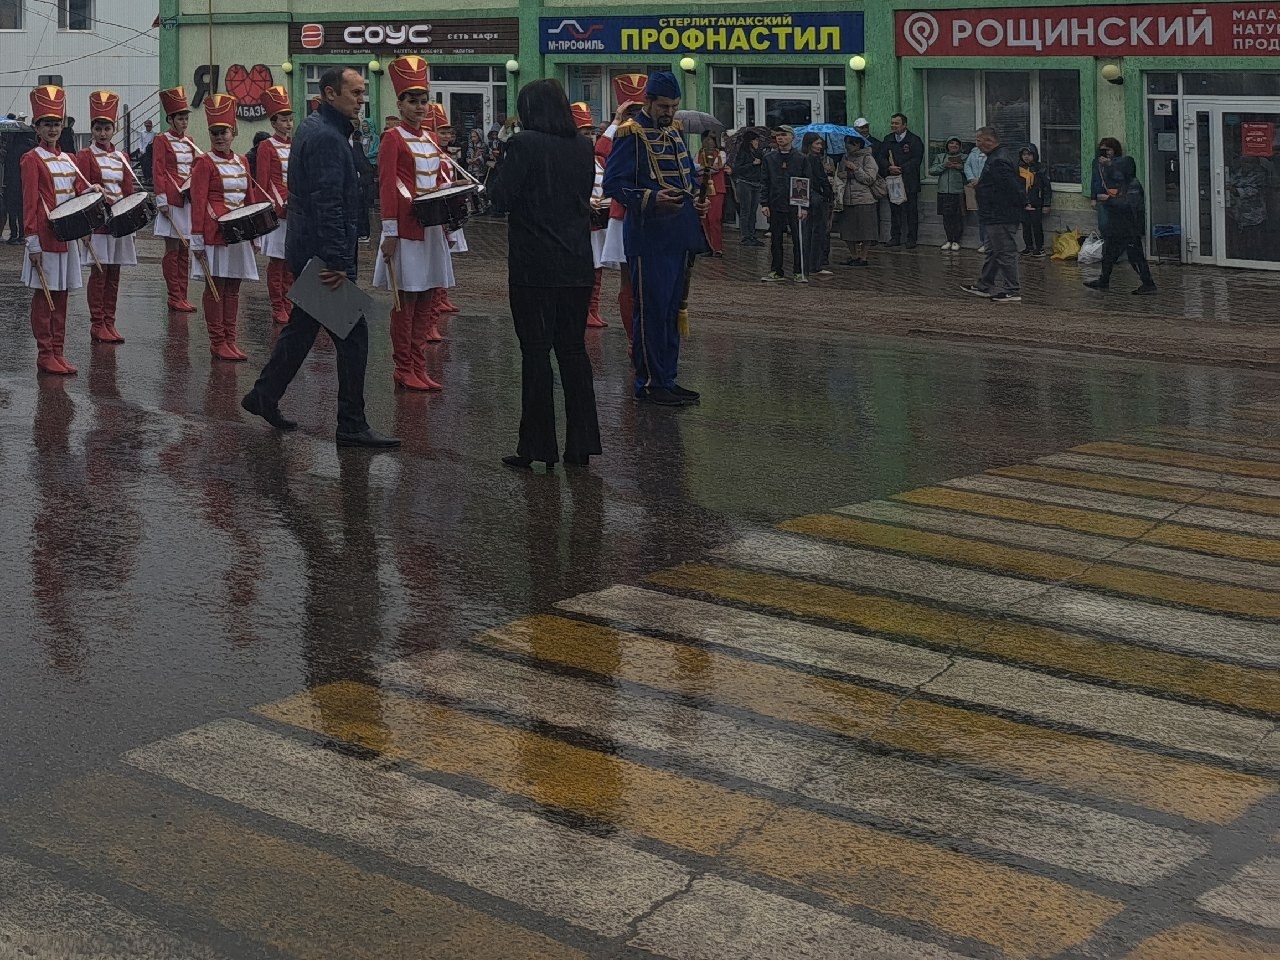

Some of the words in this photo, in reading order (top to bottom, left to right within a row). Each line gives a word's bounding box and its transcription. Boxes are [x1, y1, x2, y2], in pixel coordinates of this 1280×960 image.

[659, 14, 792, 27] СТЕРЛИТАМАКСКИЙ
[1232, 9, 1280, 20] МАГА
[343, 24, 432, 45] СОУС
[472, 32, 499, 41] КАФЕ
[952, 8, 1213, 51] РОЩИНСКИЙ
[548, 40, 604, 51] М-ПРОФИЛЬ
[620, 26, 841, 51] ПРОФНАСТИЛ
[190, 64, 220, 108] Я
